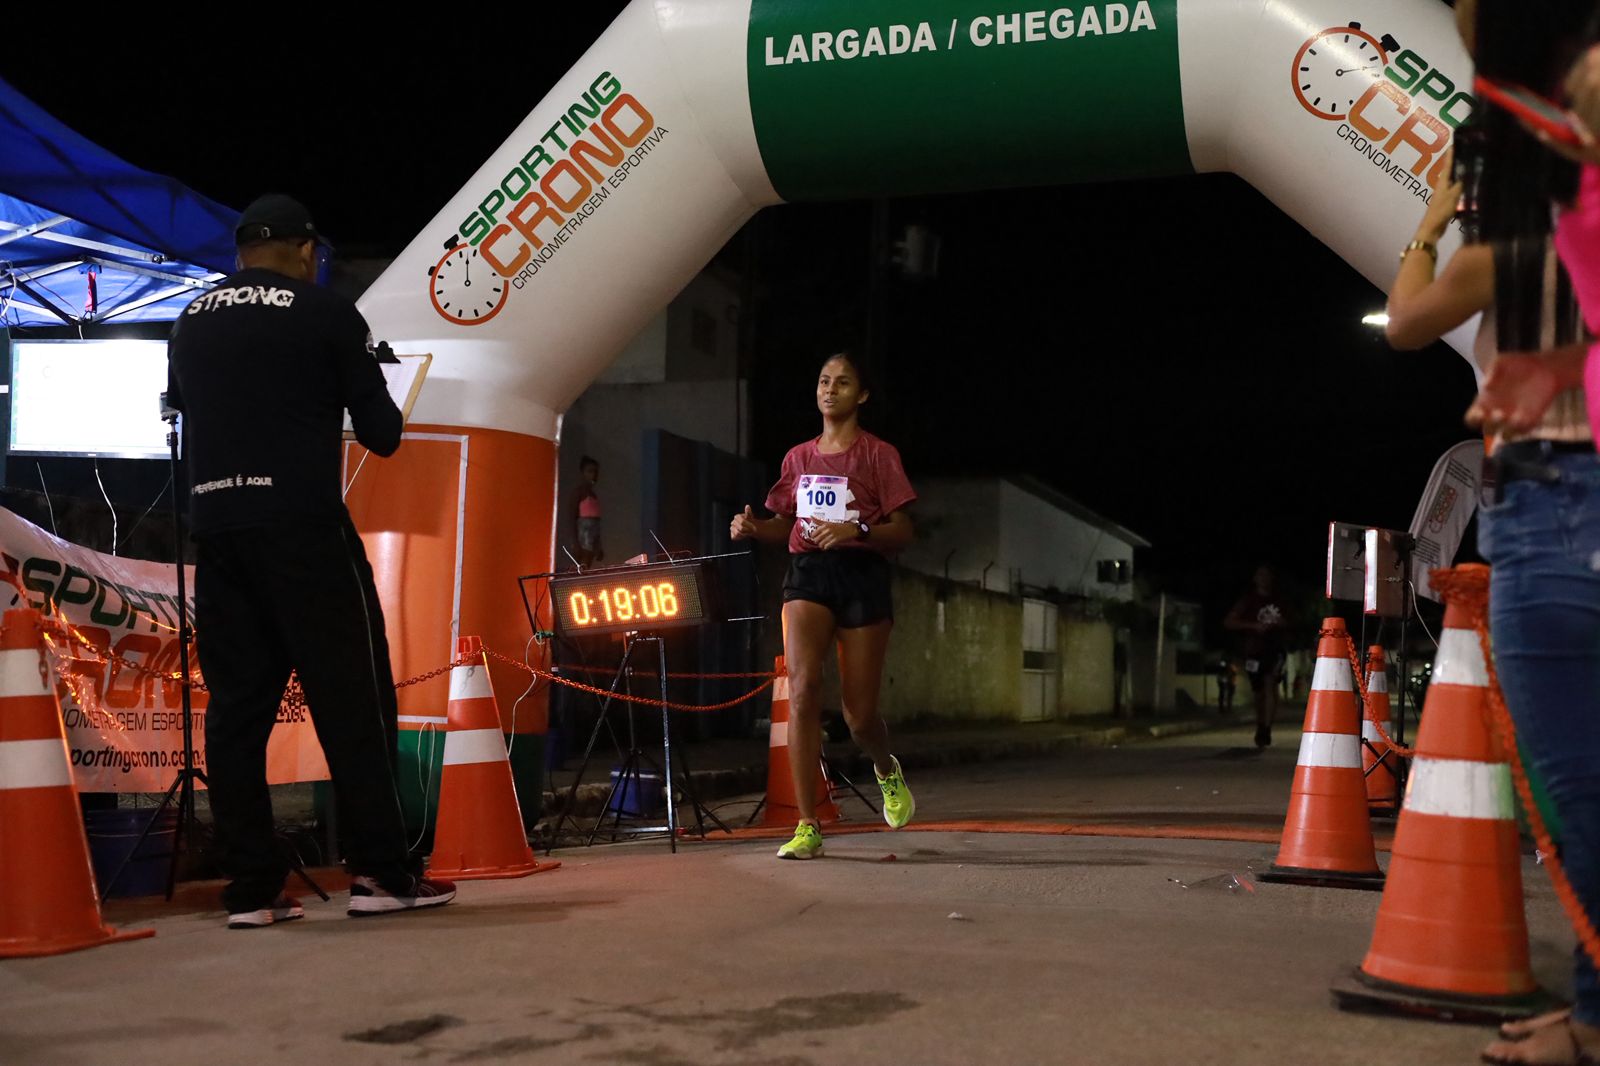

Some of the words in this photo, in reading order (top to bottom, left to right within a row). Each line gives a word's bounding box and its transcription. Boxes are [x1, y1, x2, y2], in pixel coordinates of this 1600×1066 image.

[765, 22, 937, 66] LARGADA
[948, 19, 958, 50] /
[969, 0, 1157, 47] CHEGADA
[458, 71, 622, 247] SPORTING
[479, 93, 655, 278] CRONO
[512, 186, 611, 290] CRONOMETRAGEM
[607, 126, 669, 189] ESPORTIVA
[187, 286, 295, 315] STRONG
[806, 489, 836, 507] 100
[569, 582, 679, 625] 0:19:06
[152, 712, 206, 731] ESPOTI
